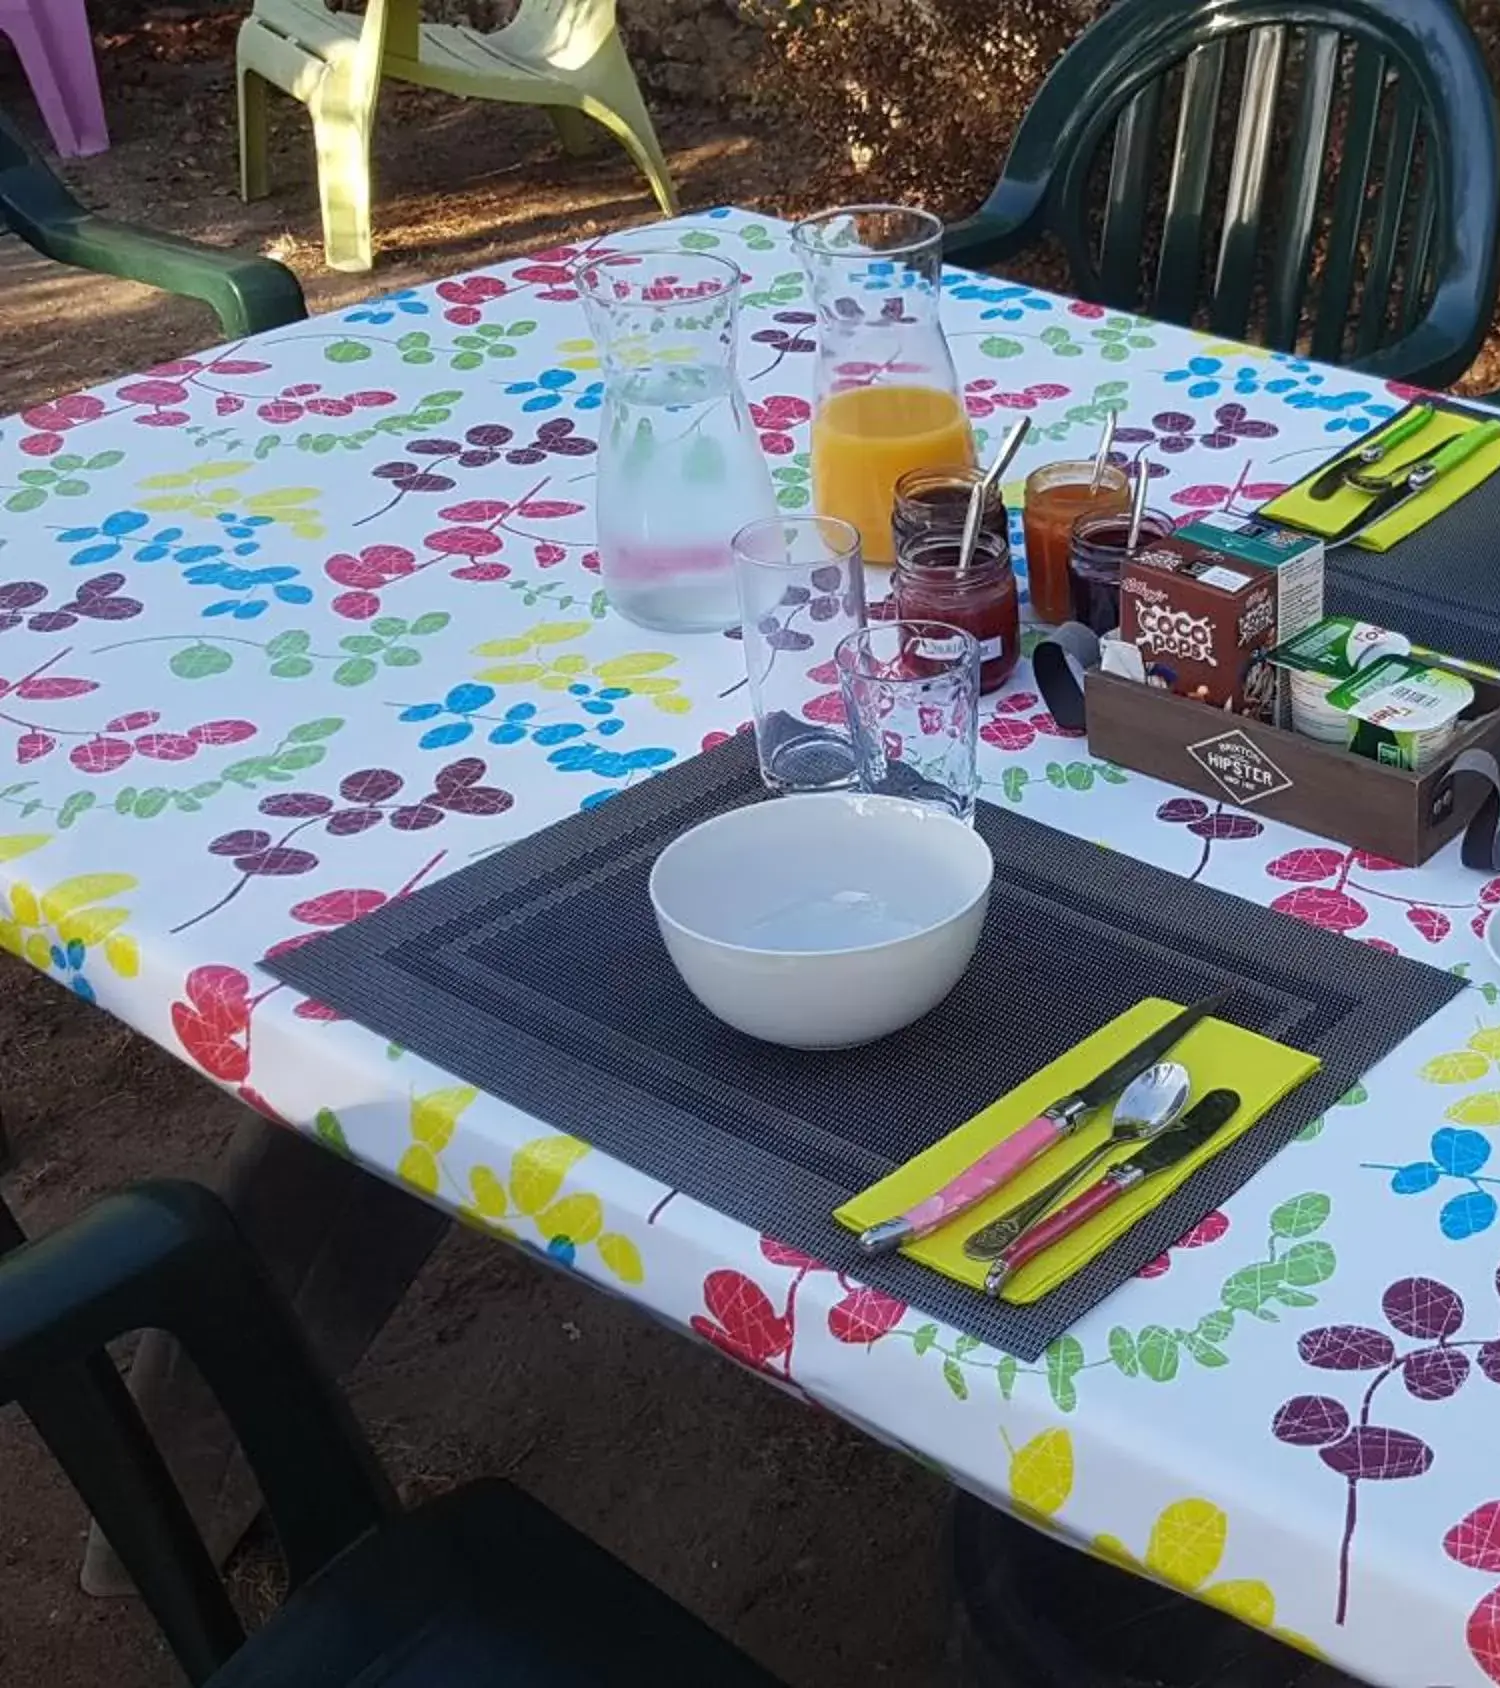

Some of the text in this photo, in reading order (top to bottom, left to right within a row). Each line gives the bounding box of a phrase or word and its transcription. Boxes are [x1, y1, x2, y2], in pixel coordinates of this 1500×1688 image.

[1139, 609, 1208, 645] COCO
[1152, 633, 1202, 659] pops
[1207, 752, 1273, 787] HIPSTER
